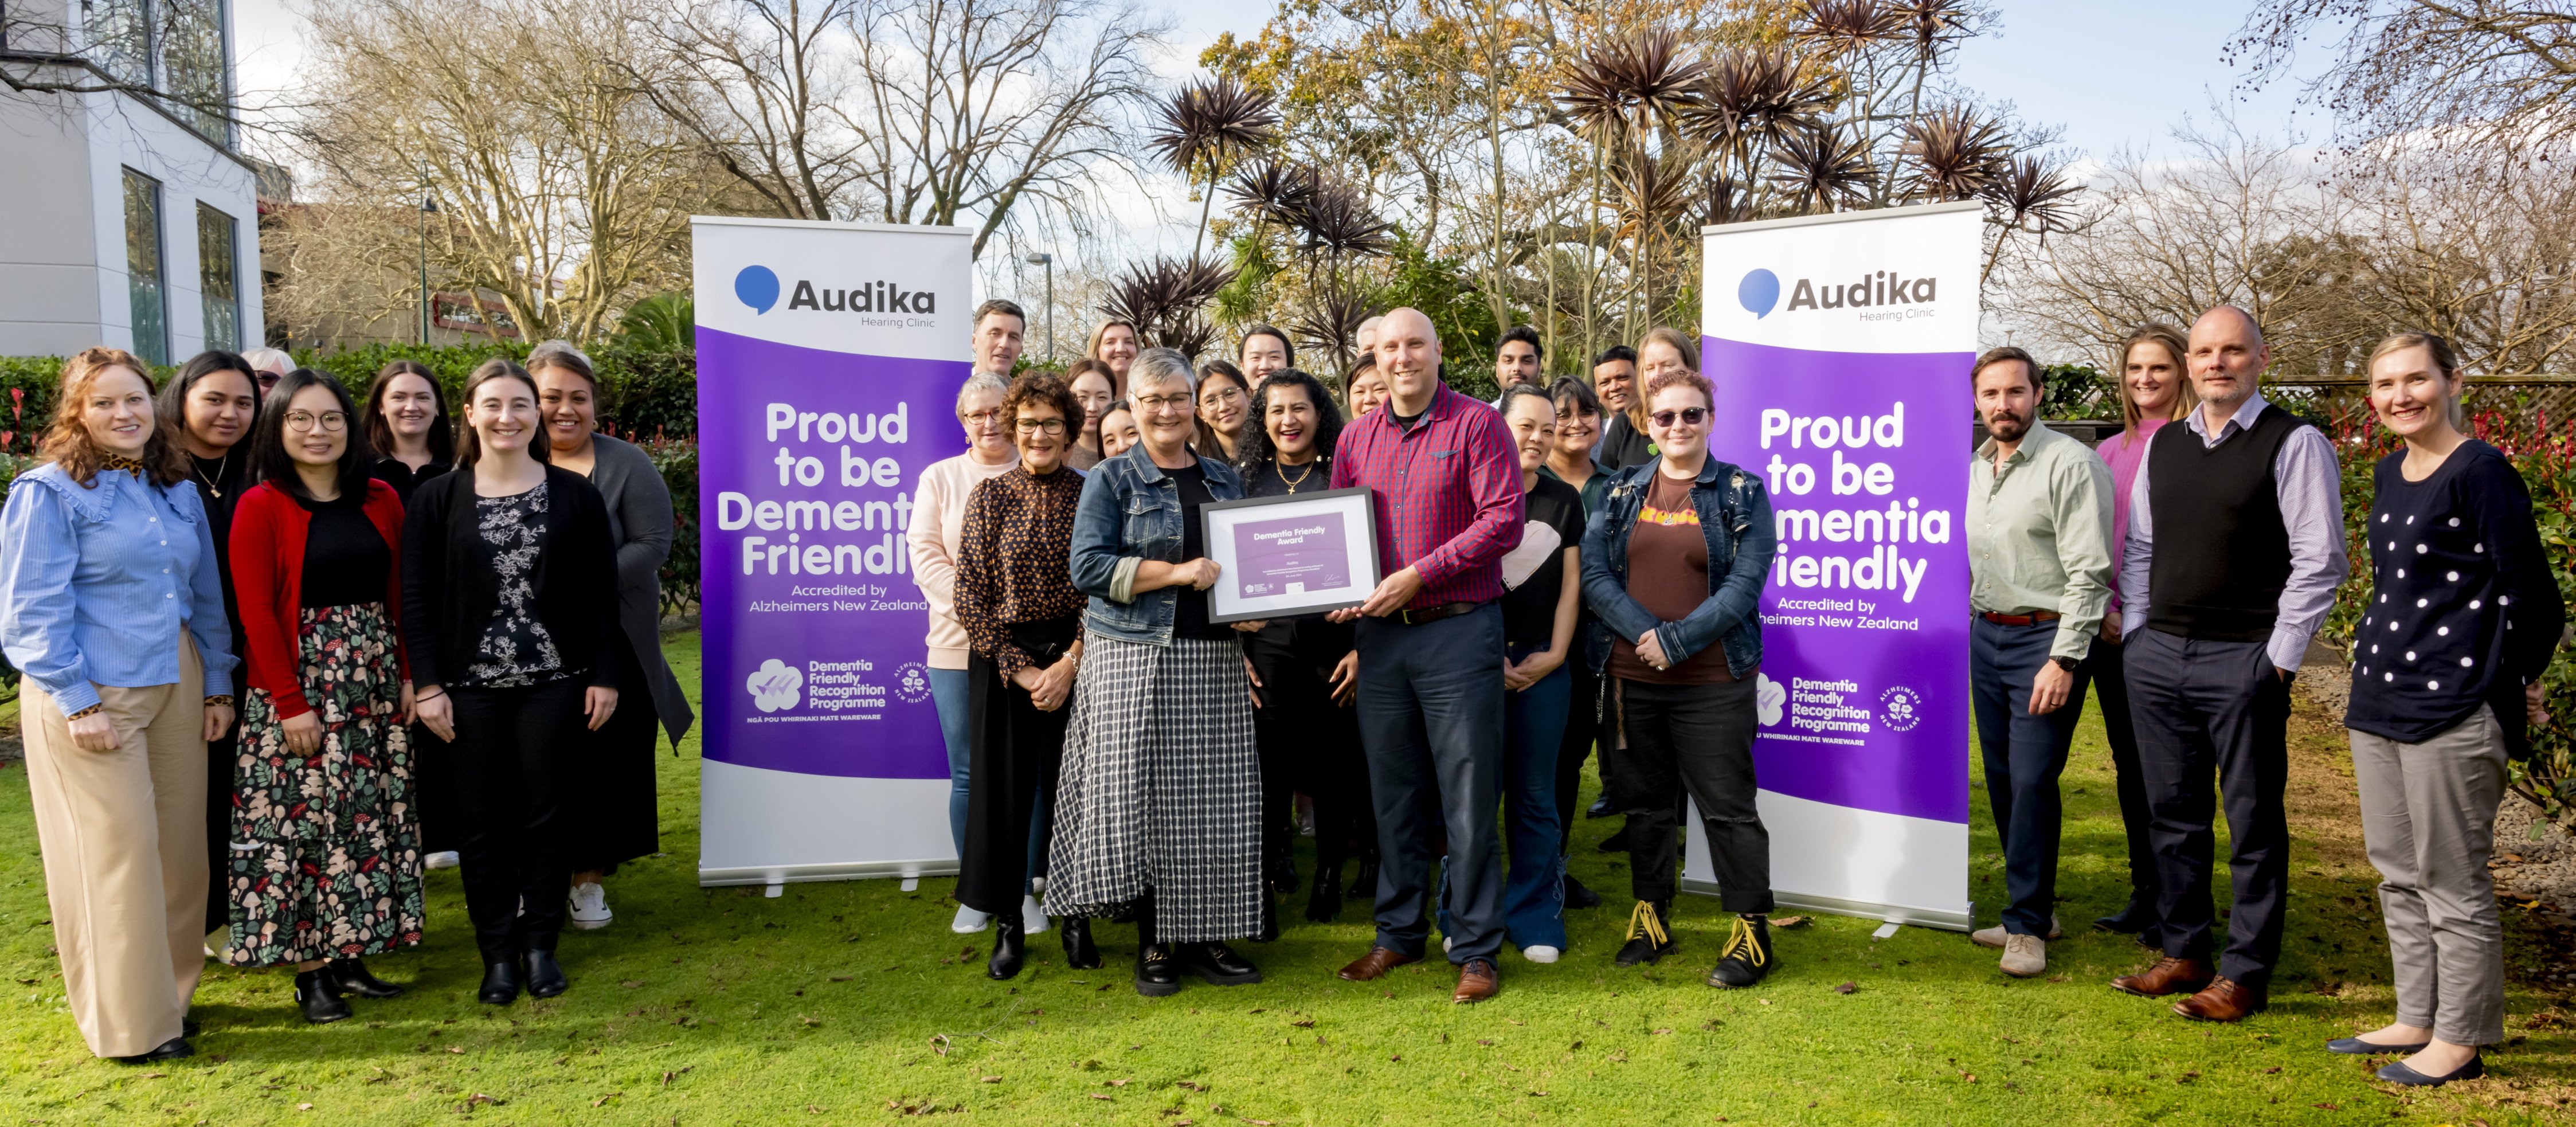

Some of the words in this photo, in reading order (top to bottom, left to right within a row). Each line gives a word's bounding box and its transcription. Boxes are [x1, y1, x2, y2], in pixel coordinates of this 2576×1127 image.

[788, 280, 935, 314] Audika
[1787, 270, 1936, 311] Audika
[862, 316, 903, 328] Hearing
[906, 318, 935, 328] Clinic
[1859, 310, 1902, 322] Hearing
[1906, 308, 1935, 319] Clinic
[766, 402, 907, 444] Proud
[1760, 401, 1904, 449] Proud
[774, 447, 824, 487] to
[841, 445, 900, 487] be
[1766, 453, 1815, 495] to
[1831, 450, 1894, 495] be
[718, 491, 917, 531] Dement
[1776, 497, 1950, 543] mentia
[1254, 530, 1293, 541] Dementia
[1294, 526, 1325, 536] Friendly
[1277, 535, 1303, 545] Award
[742, 533, 918, 585] Friendl
[1772, 543, 1927, 603] iendly
[792, 584, 866, 596] Accredited
[870, 584, 887, 598] by
[749, 600, 829, 612] Alzheimers
[833, 600, 865, 611] New
[870, 598, 927, 611] Zealand
[1778, 597, 1853, 612] Accredited
[1858, 600, 1876, 615] by
[1759, 612, 1815, 627] heimers
[1819, 615, 1853, 628] New
[1857, 616, 1919, 631] Zealand
[809, 659, 873, 672] Dementia
[894, 662, 929, 677] ALZHEIMER
[809, 671, 860, 686] Friendly
[1792, 677, 1857, 693] Dementia
[809, 684, 886, 698] Recognition
[895, 689, 906, 701] NEW
[907, 688, 931, 703] ZEALAND
[1792, 690, 1844, 707] Friendly
[1880, 686, 1921, 704] ALZHEIMERS
[809, 697, 886, 711] Programme
[1792, 703, 1870, 721] Recognition
[1791, 716, 1870, 733] Programme
[1880, 715, 1892, 727] NEW
[1893, 717, 1920, 731] ZEALAND
[1763, 733, 1800, 741] WHIRINAKI
[1822, 737, 1865, 746] WAREWARE
